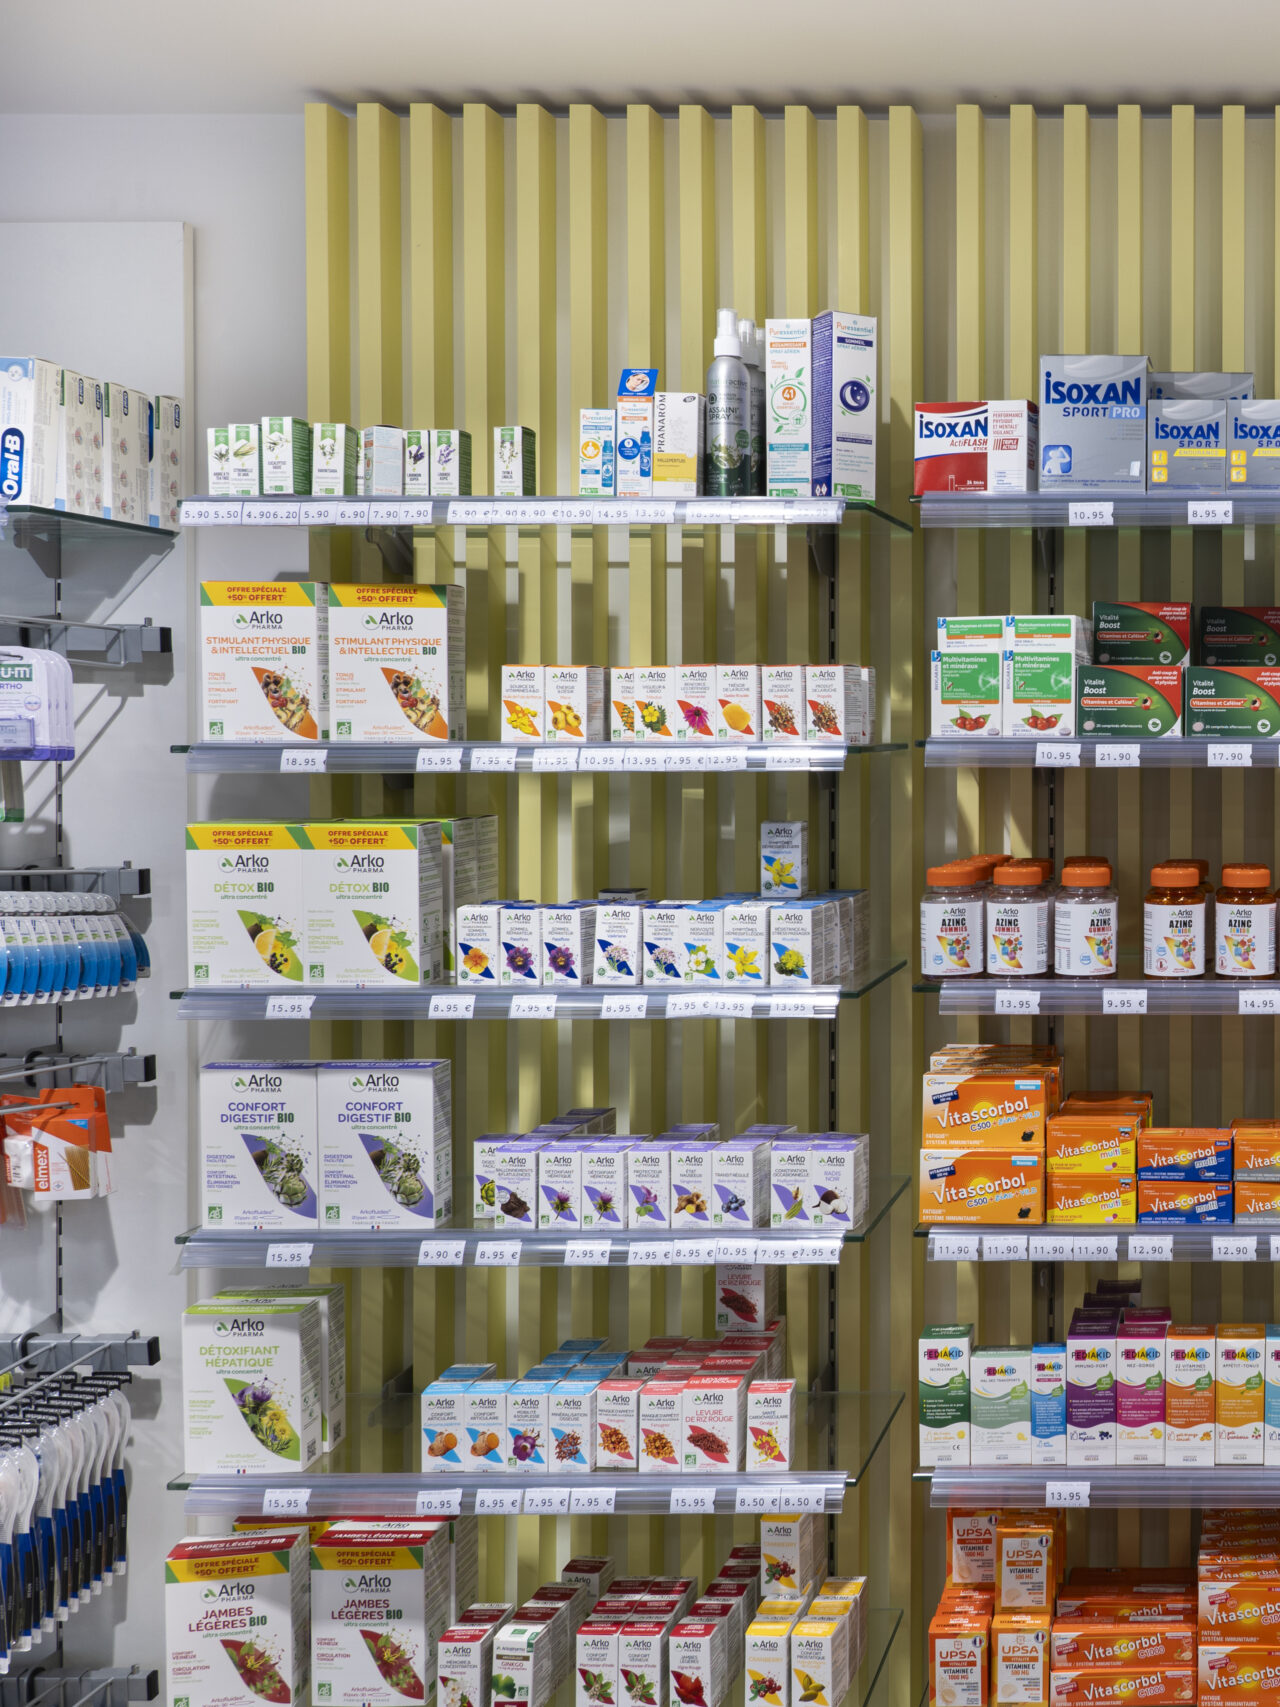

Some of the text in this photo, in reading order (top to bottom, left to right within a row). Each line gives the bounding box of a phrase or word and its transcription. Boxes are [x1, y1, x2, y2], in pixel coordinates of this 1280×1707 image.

[770, 327, 808, 336] Puressentiel
[836, 322, 874, 334] Puressentiel
[1063, 407, 1140, 418] SPORT PRO
[2, 435, 20, 495] Oral-B
[598, 510, 628, 518] 14.95
[1192, 510, 1220, 518] 8.95
[250, 611, 283, 624] Arko
[206, 637, 310, 645] STIMULANT PHYSIQUE
[292, 646, 306, 654] BIO
[1084, 687, 1106, 695] Boost
[1041, 752, 1071, 760] 10.95
[214, 881, 274, 892] DÉTOX BIO
[942, 918, 966, 927] AZINC
[1000, 1000, 1031, 1008] 13.95
[228, 1102, 286, 1111] CONFORT
[937, 1097, 1029, 1128] Vitascorbol
[221, 1113, 294, 1123] DIGESTIF BIO
[970, 1122, 991, 1132] C500
[38, 1148, 47, 1190] elmex
[1150, 1191, 1216, 1212] Vitascorbol
[424, 1251, 448, 1259] 9.90
[939, 1246, 969, 1254] 11.90
[200, 1344, 279, 1356] DÉTOXIFIANT
[924, 1349, 963, 1359] PEDIAKID
[206, 1356, 273, 1368] HÉPATIQUE
[1050, 1492, 1081, 1500] 13.95
[268, 1500, 298, 1508] 15.95
[529, 1499, 554, 1507] 7.95
[957, 1528, 992, 1537] UPSA
[358, 1575, 391, 1588] Arko
[203, 1606, 253, 1620] JAMBES
[189, 1616, 267, 1632] LÉGÈRES BIO
[1084, 1633, 1161, 1660] Vitascorbol
